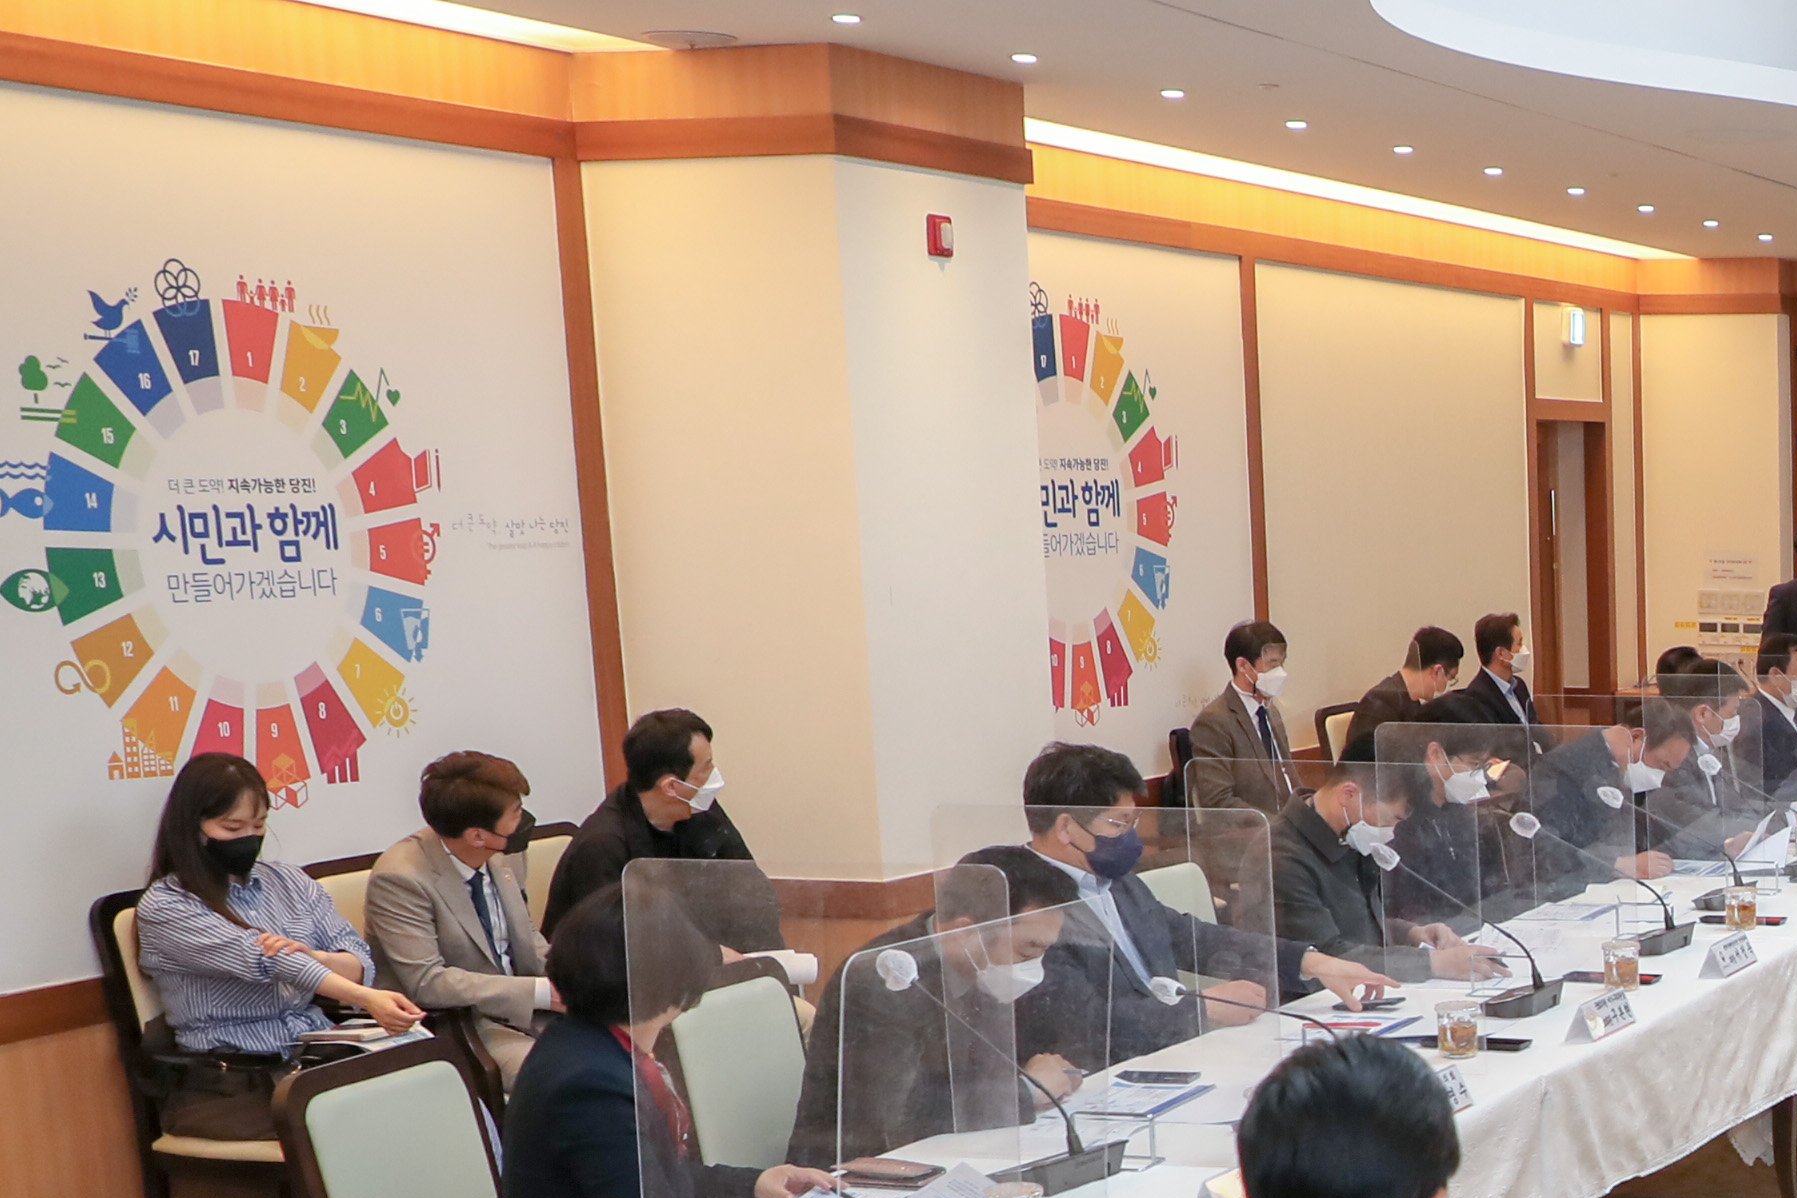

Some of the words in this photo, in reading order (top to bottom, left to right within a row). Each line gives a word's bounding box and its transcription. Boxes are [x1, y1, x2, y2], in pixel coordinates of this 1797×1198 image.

[188, 350, 199, 366] 17
[246, 352, 253, 367] 1
[138, 373, 151, 389] 16
[299, 377, 306, 392] 2
[339, 419, 347, 434] 3
[101, 427, 114, 444] 15
[1060, 458, 1092, 471] 지속가능한
[168, 479, 180, 494] 더
[183, 479, 195, 494] 큰
[198, 478, 224, 494] 도약!
[227, 478, 286, 494] 지속가능한
[289, 478, 316, 494] 당진!
[369, 481, 375, 496] 4
[84, 492, 98, 509] 14
[1081, 478, 1120, 527] 함께
[153, 503, 263, 565] 시민과
[267, 503, 339, 563] 함께
[379, 545, 387, 560] 5
[92, 572, 106, 588] 13
[167, 568, 338, 603] 만들어가겠습니다
[374, 607, 382, 622] 6
[121, 641, 134, 657] 12
[1106, 640, 1112, 655] 8
[355, 664, 361, 679] 7
[168, 696, 180, 711] 11
[318, 702, 326, 719] 8
[217, 721, 230, 737] 10
[271, 723, 278, 738] 9
